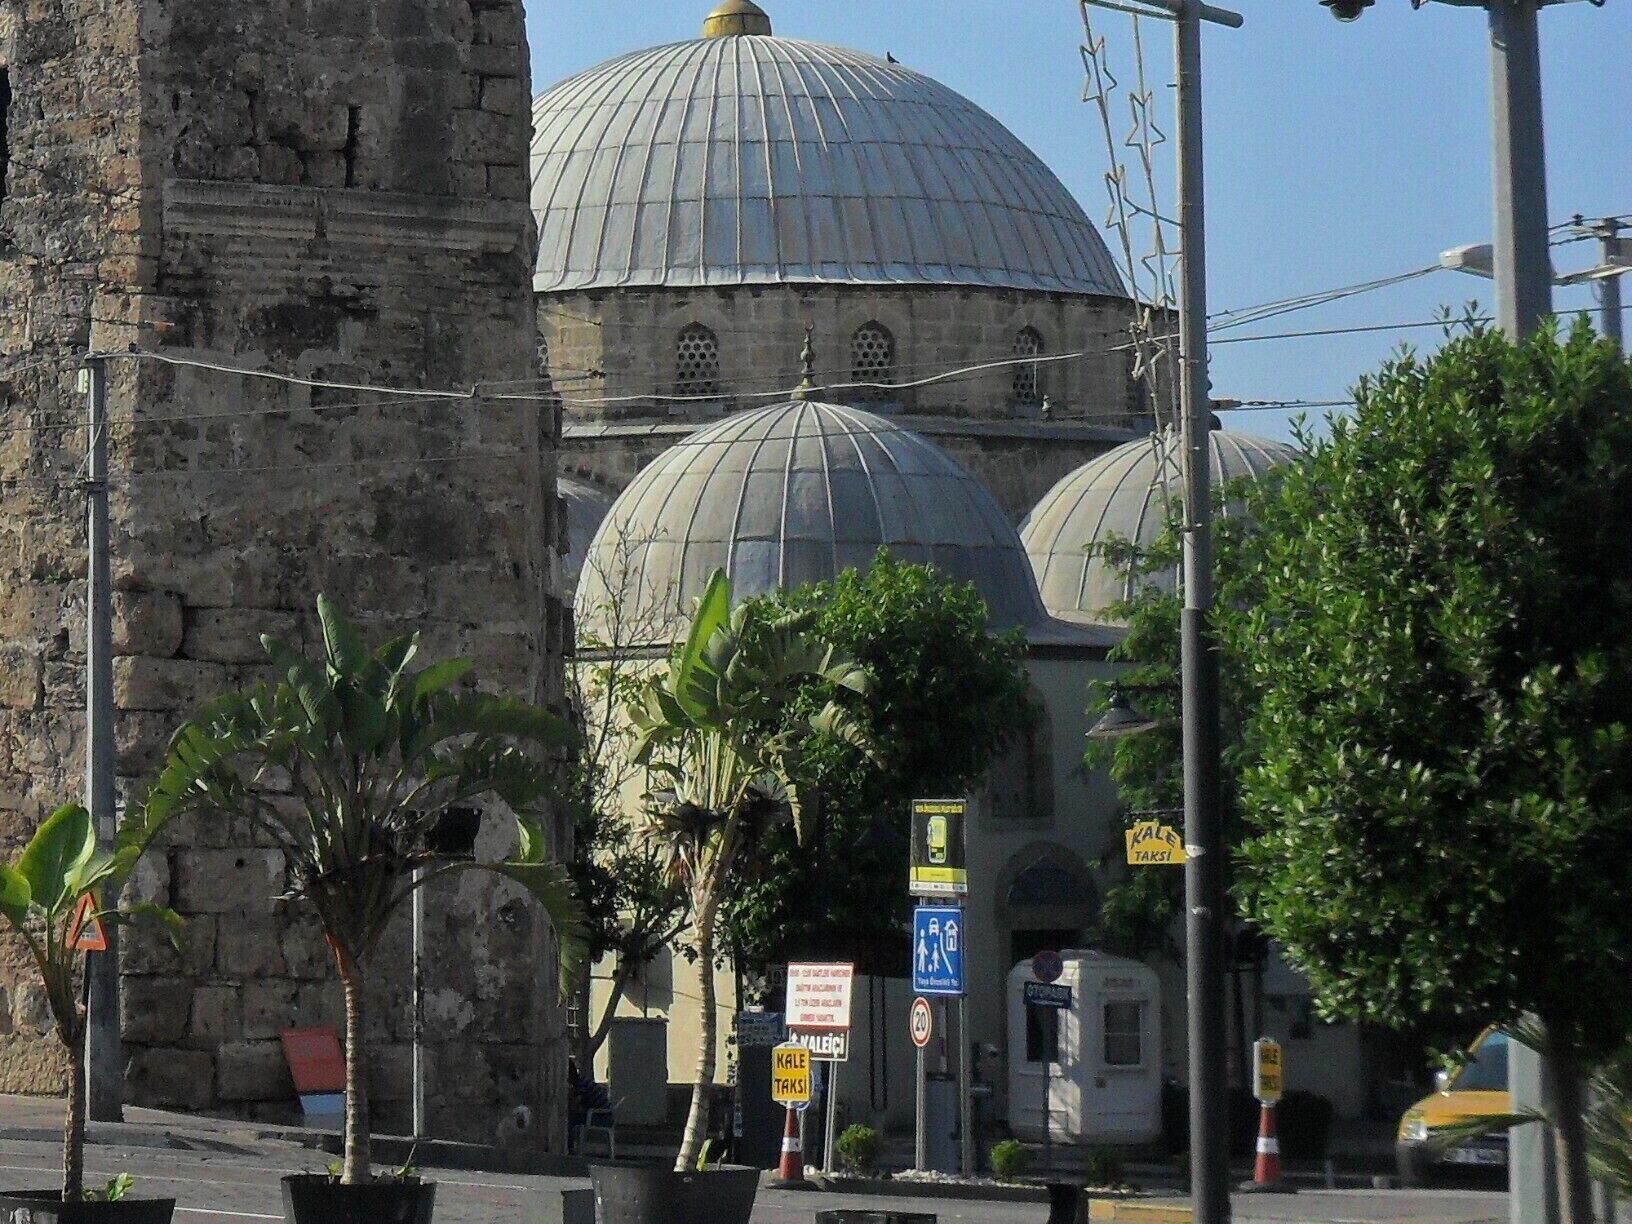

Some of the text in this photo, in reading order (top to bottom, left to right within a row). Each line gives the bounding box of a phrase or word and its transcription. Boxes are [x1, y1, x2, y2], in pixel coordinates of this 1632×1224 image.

[1131, 826, 1177, 849] KALE
[915, 1011, 926, 1031] 20
[777, 1053, 806, 1069] KALE
